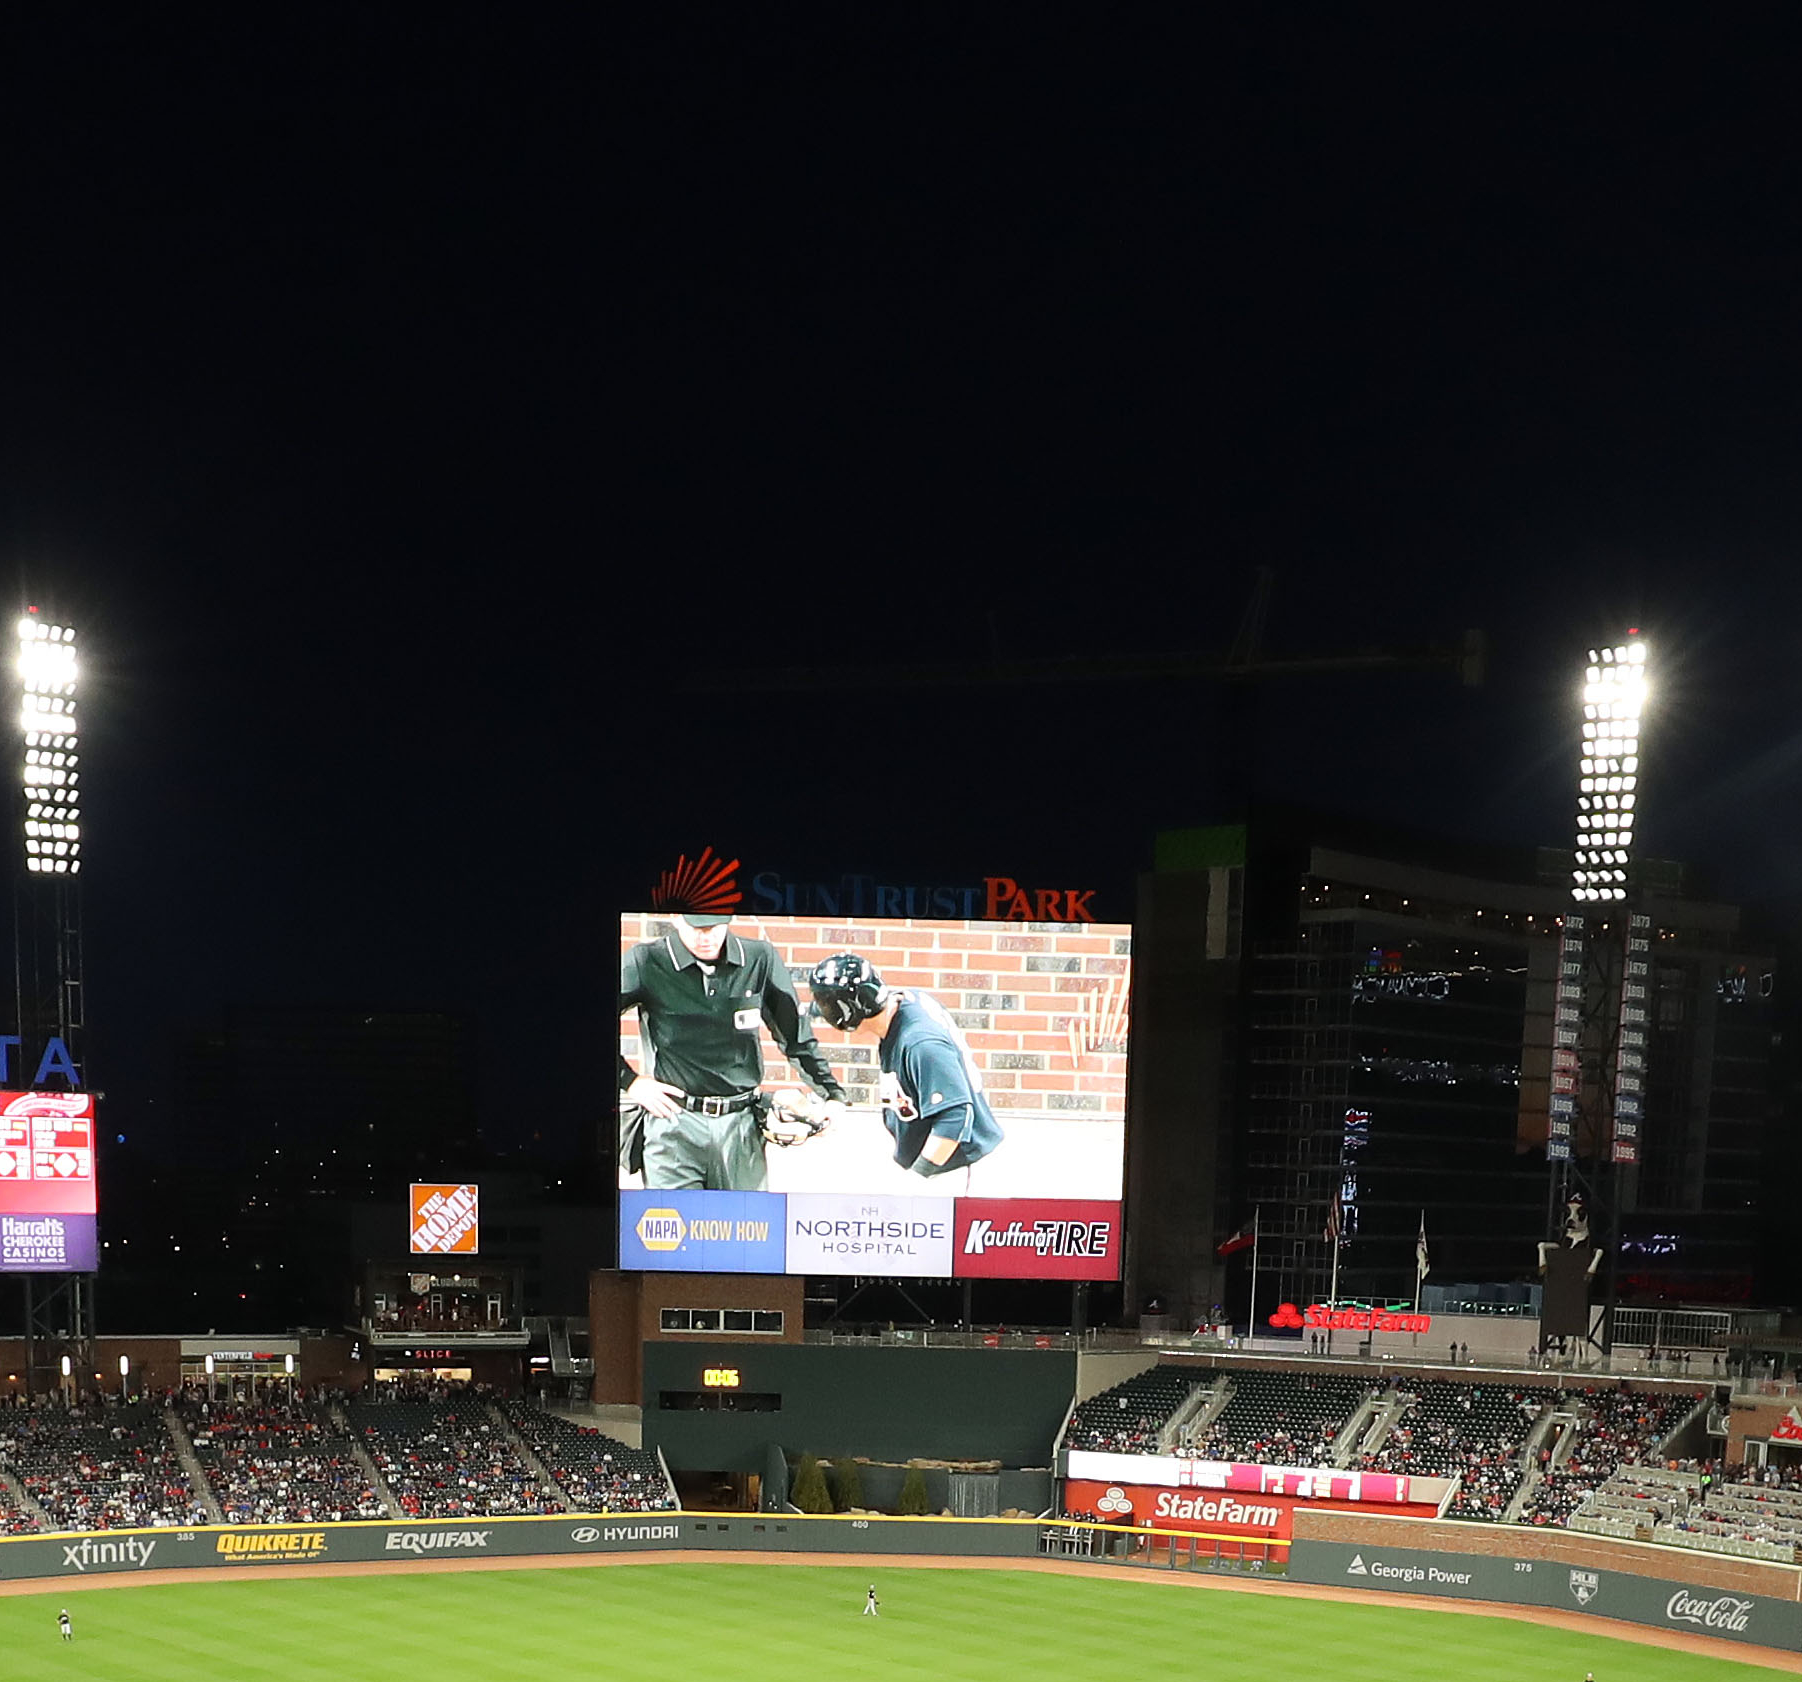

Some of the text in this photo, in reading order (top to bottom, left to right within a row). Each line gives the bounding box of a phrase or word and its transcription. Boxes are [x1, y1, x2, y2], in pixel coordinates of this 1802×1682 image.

[417, 1192, 447, 1219] THE
[1, 1217, 64, 1236] Harrah's
[411, 1185, 478, 1253] HOME
[795, 1220, 945, 1238] NORTHSIDE
[436, 1209, 478, 1253] DEPOT
[645, 1219, 769, 1242] NAPA KNOW HOW
[963, 1220, 1109, 1256] Kauffman TIRE
[3, 1236, 65, 1247] CHEROKEE
[822, 1242, 918, 1255] HOSPITAL
[2, 1248, 65, 1257] CASINOS
[415, 1350, 452, 1359] SLICE
[603, 1525, 680, 1541] HYUNDAI
[851, 1519, 869, 1529] 400
[217, 1532, 326, 1554] QUIKRETE
[384, 1531, 489, 1554] EQUIFAX
[62, 1536, 156, 1571] xfinity
[224, 1554, 245, 1562] What
[284, 1551, 306, 1559] Made
[1371, 1561, 1472, 1585] Georgia Power
[1513, 1562, 1532, 1573] 375
[1666, 1590, 1754, 1632] Coca-Cola
